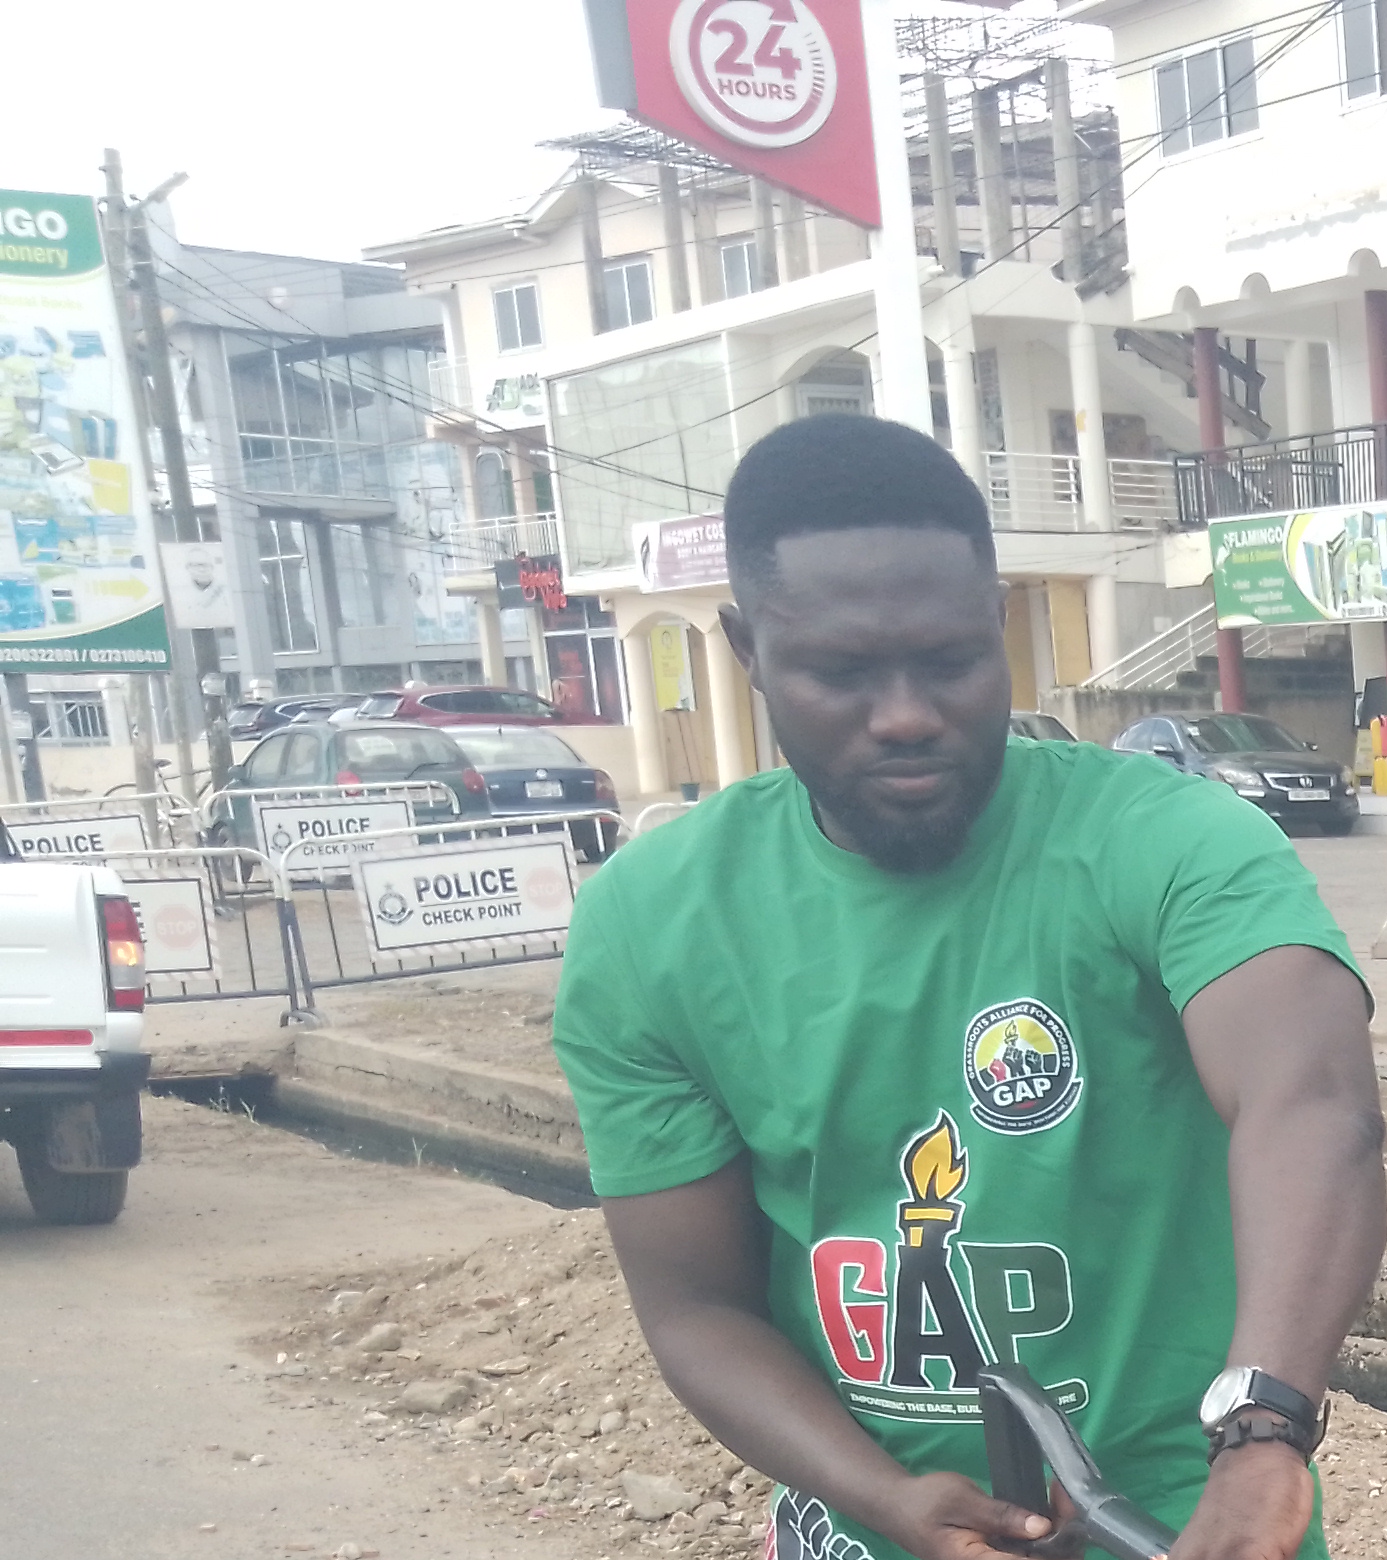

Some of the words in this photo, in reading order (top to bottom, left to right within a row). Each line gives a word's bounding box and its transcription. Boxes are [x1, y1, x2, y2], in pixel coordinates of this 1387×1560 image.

[706, 19, 802, 80] 24
[717, 78, 797, 101] HOURS
[0, 207, 68, 241] GO
[1228, 526, 1284, 548] FLAMINGO
[299, 817, 371, 839] POLICE
[21, 832, 105, 854] POLICE
[414, 867, 518, 903] POLICE
[527, 883, 563, 897] STOP
[422, 908, 475, 926] CHECK
[479, 902, 522, 920] POINT
[155, 921, 196, 938] STOP
[966, 1016, 990, 1080] GRASSROOTS
[990, 1004, 1030, 1022] ALLIANCE
[1030, 1006, 1048, 1023] FOR
[1047, 1020, 1071, 1068] PROGRESS
[993, 1078, 1052, 1107] GAP
[811, 1210, 1074, 1392] GAP
[906, 1402, 926, 1412] THE
[927, 1403, 956, 1415] BASE,
[957, 1404, 983, 1414] BUIL
